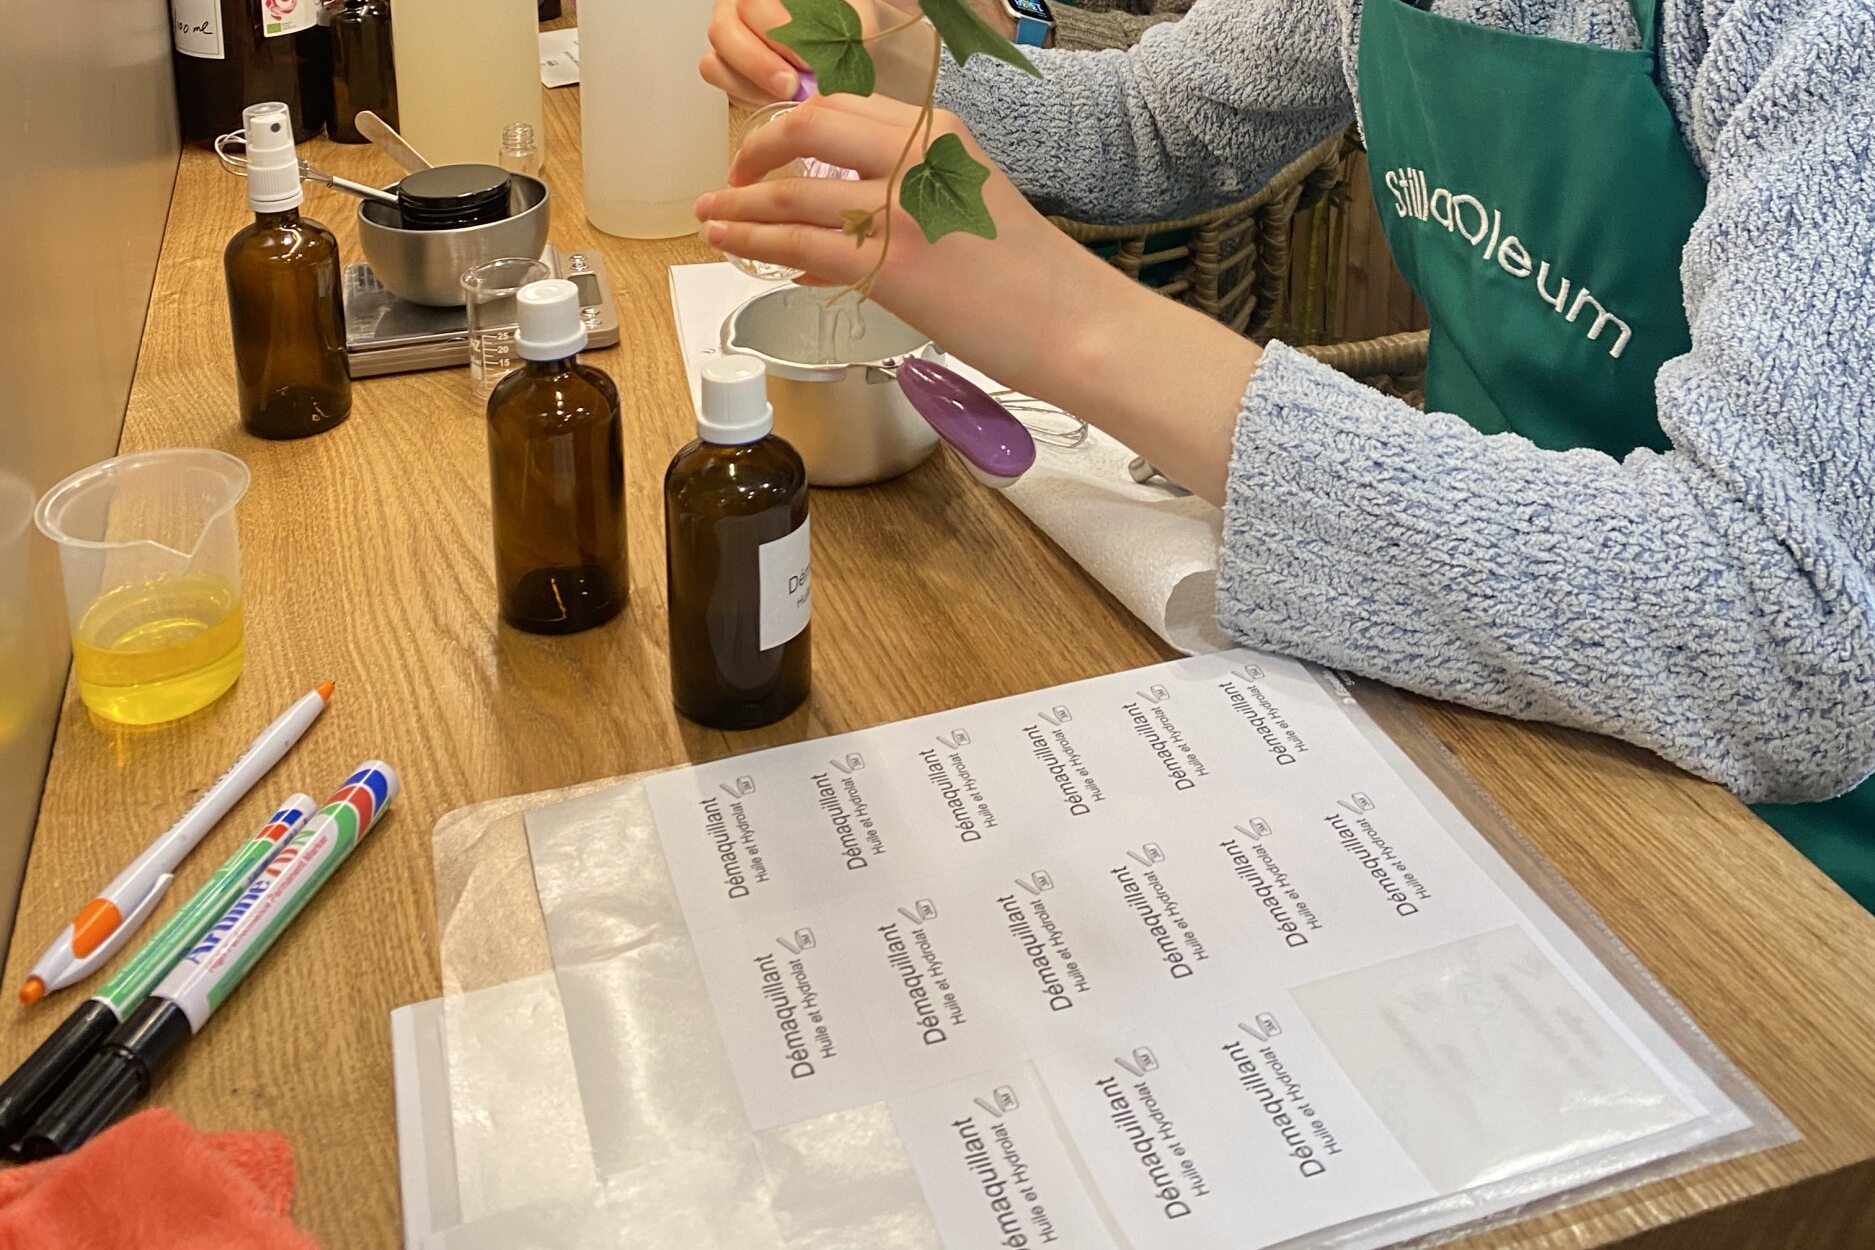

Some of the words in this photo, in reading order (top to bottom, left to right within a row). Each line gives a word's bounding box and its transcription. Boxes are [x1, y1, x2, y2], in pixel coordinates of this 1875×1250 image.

[193, 21, 213, 35] ml
[497, 332, 509, 340] 25
[497, 345, 509, 354] 20
[499, 358, 511, 367] 15
[1246, 685, 1281, 720] Hydrolat
[1150, 706, 1184, 743] Hydrolat
[1218, 681, 1296, 766] Démaquillant
[1275, 719, 1289, 729] et
[1051, 729, 1083, 767] Hydrolat
[1121, 702, 1196, 791] Démaquillant
[1177, 743, 1191, 753] et
[1285, 730, 1309, 753] Huile
[948, 752, 978, 792] Hydrolat
[1022, 724, 1091, 816] Démaquillant
[1075, 767, 1089, 777] et
[1187, 754, 1209, 777] Huile
[841, 777, 868, 817] Hydrolat
[918, 748, 982, 843] Démaquillant
[969, 791, 983, 802] et
[1084, 778, 1106, 802] Huile
[729, 802, 755, 844] Hydrolat
[810, 772, 868, 870] Démaquillant
[859, 817, 873, 828] et
[977, 803, 998, 828] Huile
[699, 797, 750, 899] Démaquillant
[745, 844, 759, 855] et
[866, 830, 886, 855] Huile
[1356, 818, 1397, 861] Hydrolat
[750, 857, 770, 883] Huile
[1251, 844, 1291, 888] Hydrolat
[1323, 813, 1419, 917] Démaquillant
[1391, 860, 1407, 871] et
[1143, 870, 1180, 917] Hydrolat
[1219, 839, 1309, 948] Démaquillant
[1284, 888, 1300, 900] et
[1403, 873, 1431, 900] Huile
[185, 880, 270, 965] Artline
[1030, 899, 1065, 947] Hydrolat
[1110, 865, 1194, 979] Démaquillant
[1172, 917, 1188, 929] et
[1296, 902, 1323, 930] Huile
[911, 928, 944, 978] Hydrolat
[996, 894, 1074, 1012] Démaquillant
[1056, 947, 1072, 960] et
[1184, 931, 1209, 961] Huile
[790, 958, 818, 1009] Hydrolat
[877, 922, 947, 1046] Démaquillant
[934, 978, 950, 991] et
[1066, 962, 1091, 993] Huile
[753, 953, 815, 1079] Démaquillant
[807, 1010, 823, 1023] et
[943, 993, 966, 1026] Huile
[815, 1026, 837, 1059] Huile
[1258, 1046, 1304, 1102] Hydrolat
[1133, 1081, 1176, 1141] Hydrolat
[1221, 1041, 1326, 1178] Démaquillant
[1297, 1103, 1315, 1117] et
[990, 1123, 1030, 1185] Hydrolat
[1095, 1076, 1192, 1220] Démaquillant
[1168, 1142, 1186, 1156] et
[1311, 1120, 1342, 1155] Huile
[951, 1116, 1031, 1250] émaquillant
[1019, 1186, 1038, 1202] et
[1180, 1160, 1210, 1197] Huile
[1031, 1205, 1058, 1244] Huile
